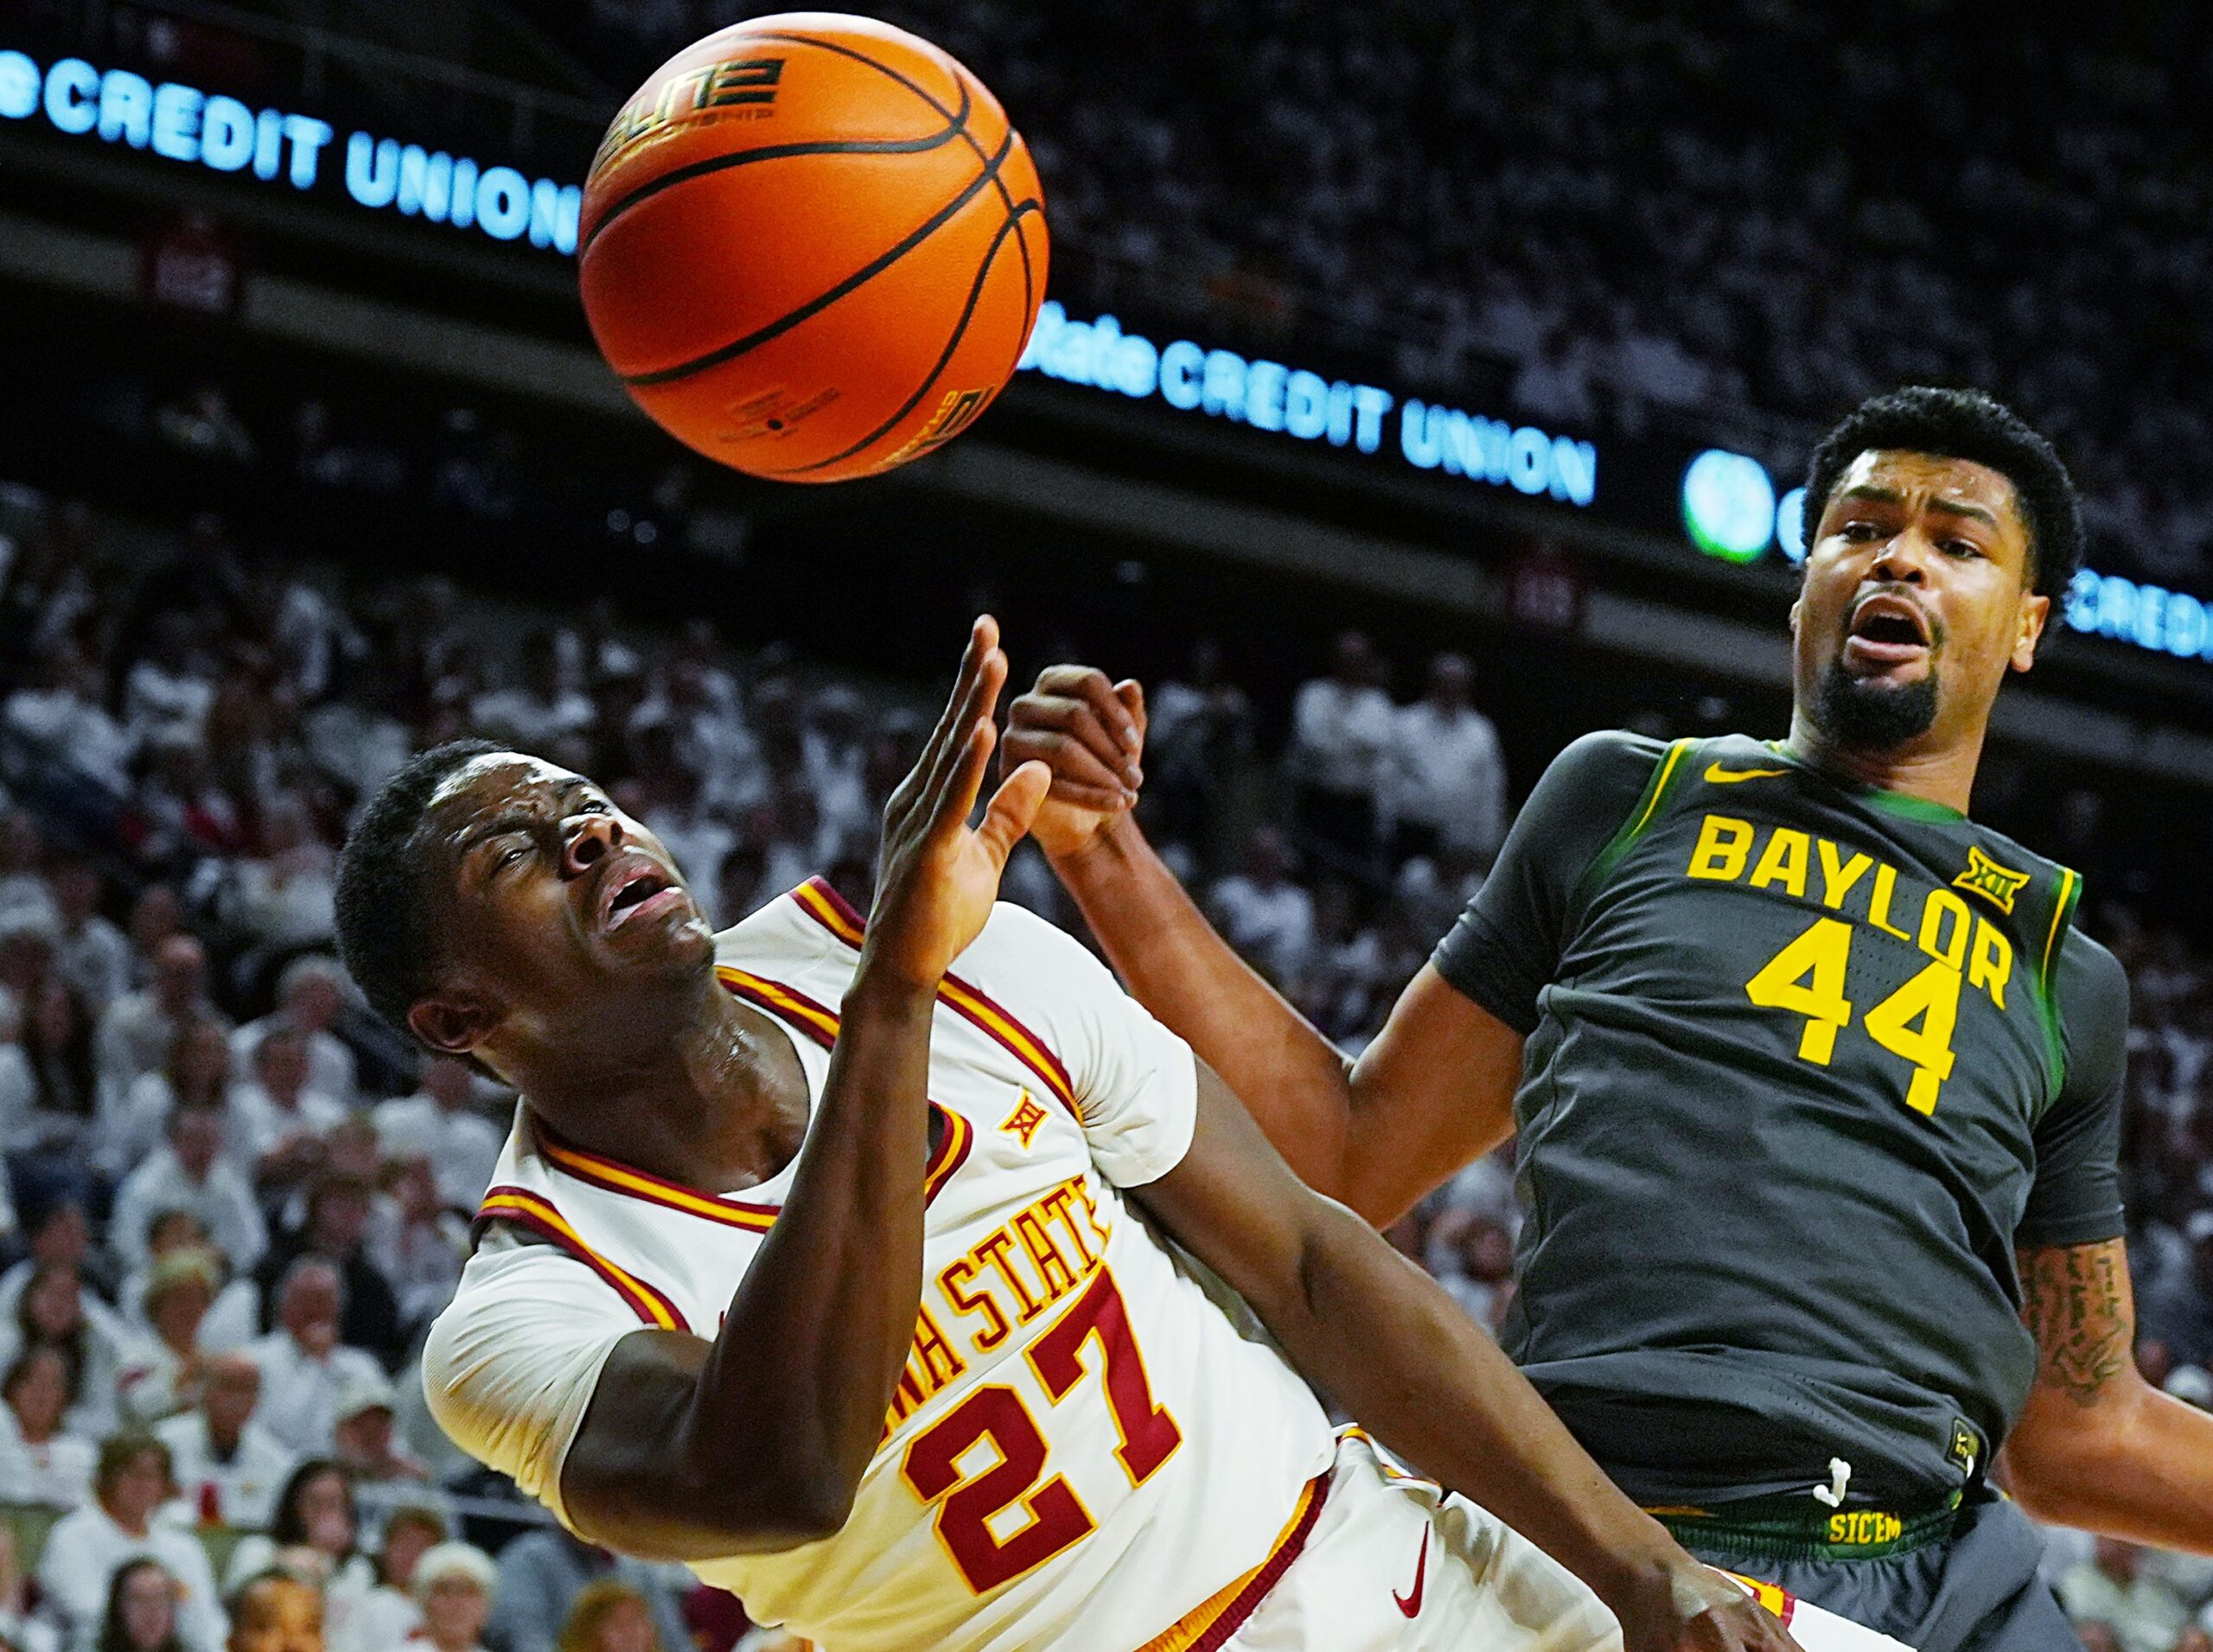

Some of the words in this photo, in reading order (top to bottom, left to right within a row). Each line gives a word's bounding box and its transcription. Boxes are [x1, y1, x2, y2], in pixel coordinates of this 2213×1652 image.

[44, 57, 334, 190] CREDIT
[346, 130, 583, 256] UNION
[1160, 340, 1393, 454] CREDIT
[1400, 398, 1598, 507] UNION
[1687, 813, 2013, 1011] BAYLOR
[1745, 915, 1963, 1117] 44
[899, 1264, 1183, 1598] 27
